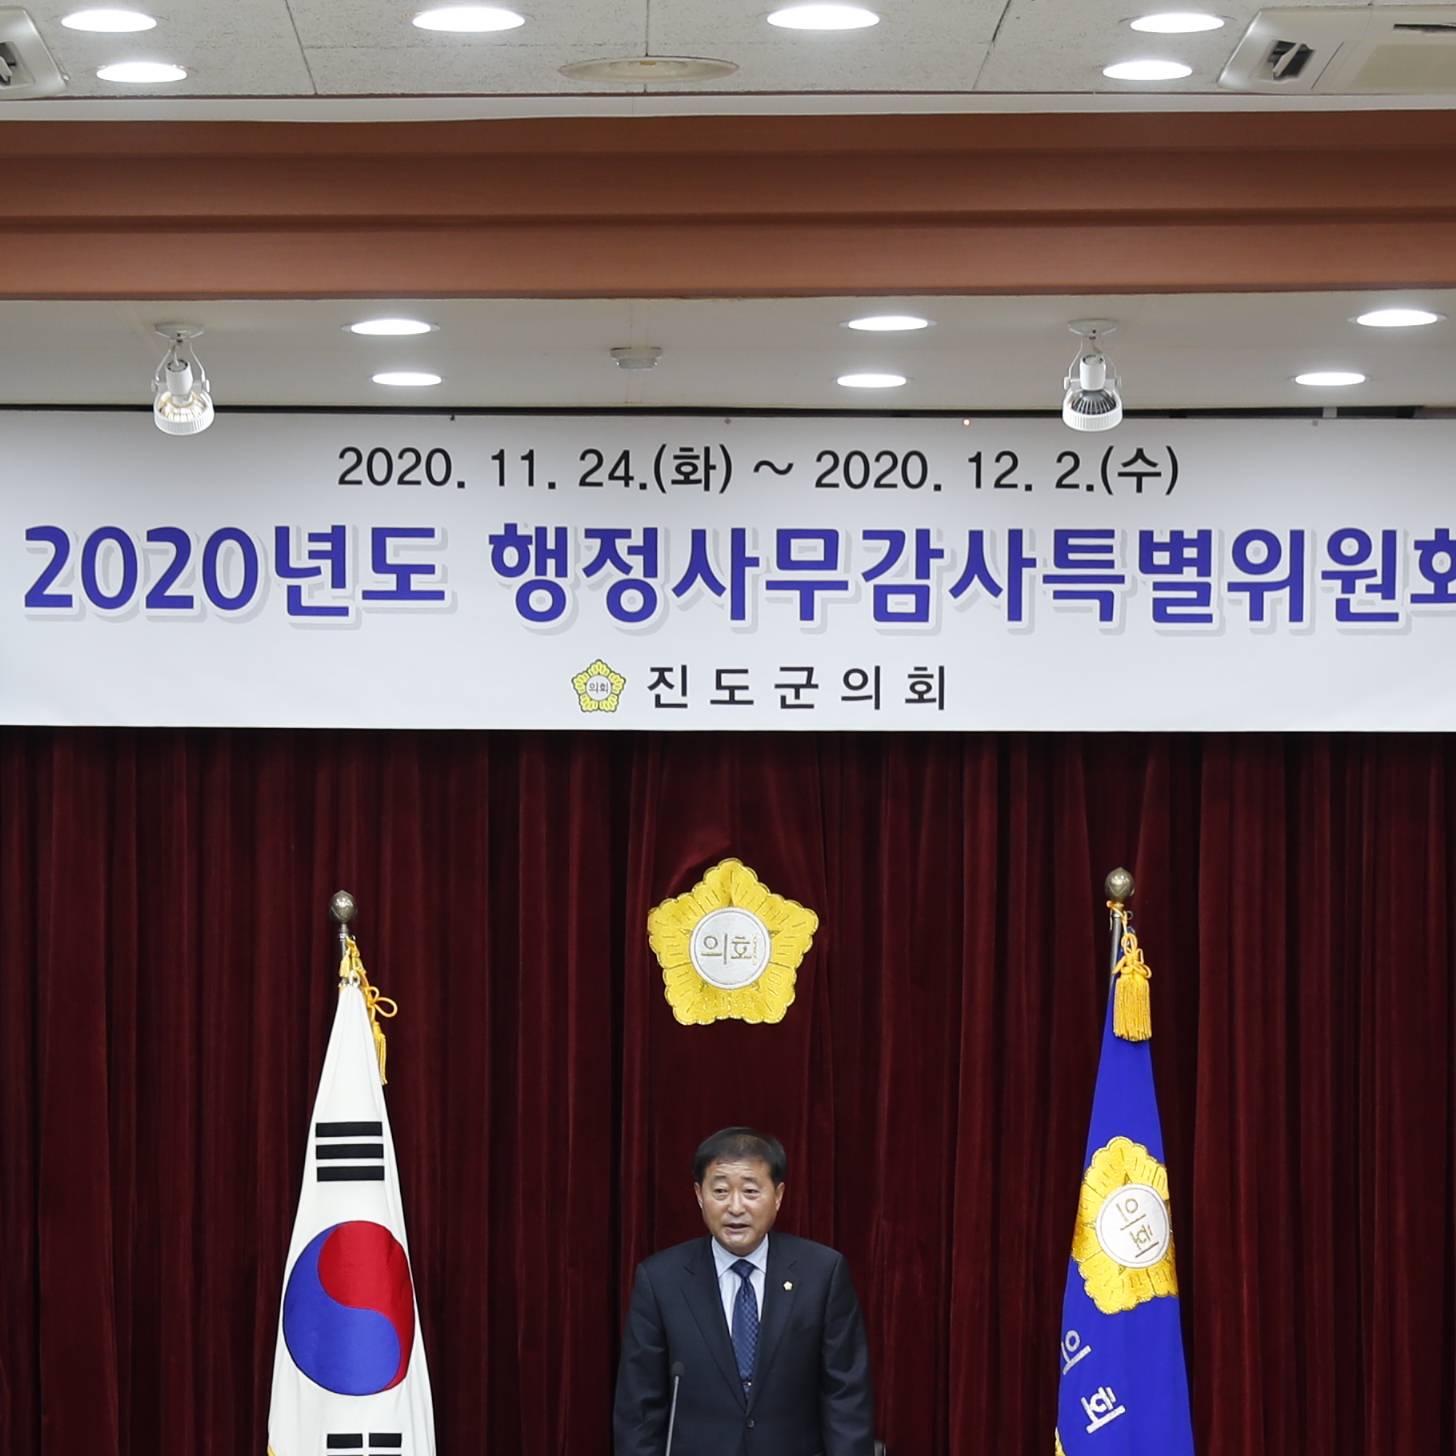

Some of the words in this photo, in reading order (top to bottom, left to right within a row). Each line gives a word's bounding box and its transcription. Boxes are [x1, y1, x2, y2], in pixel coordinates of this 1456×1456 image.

[338, 446, 466, 489] 2020.
[490, 448, 557, 490] 11.
[578, 443, 733, 494] 24.(화)
[814, 449, 942, 492] 2020.
[967, 450, 1033, 492] 12.
[1055, 444, 1179, 496] 2.(수)
[23, 523, 448, 620] 2020년도
[589, 682, 609, 694] 의회
[701, 932, 759, 966] 의회
[1115, 1197, 1160, 1259] 의회
